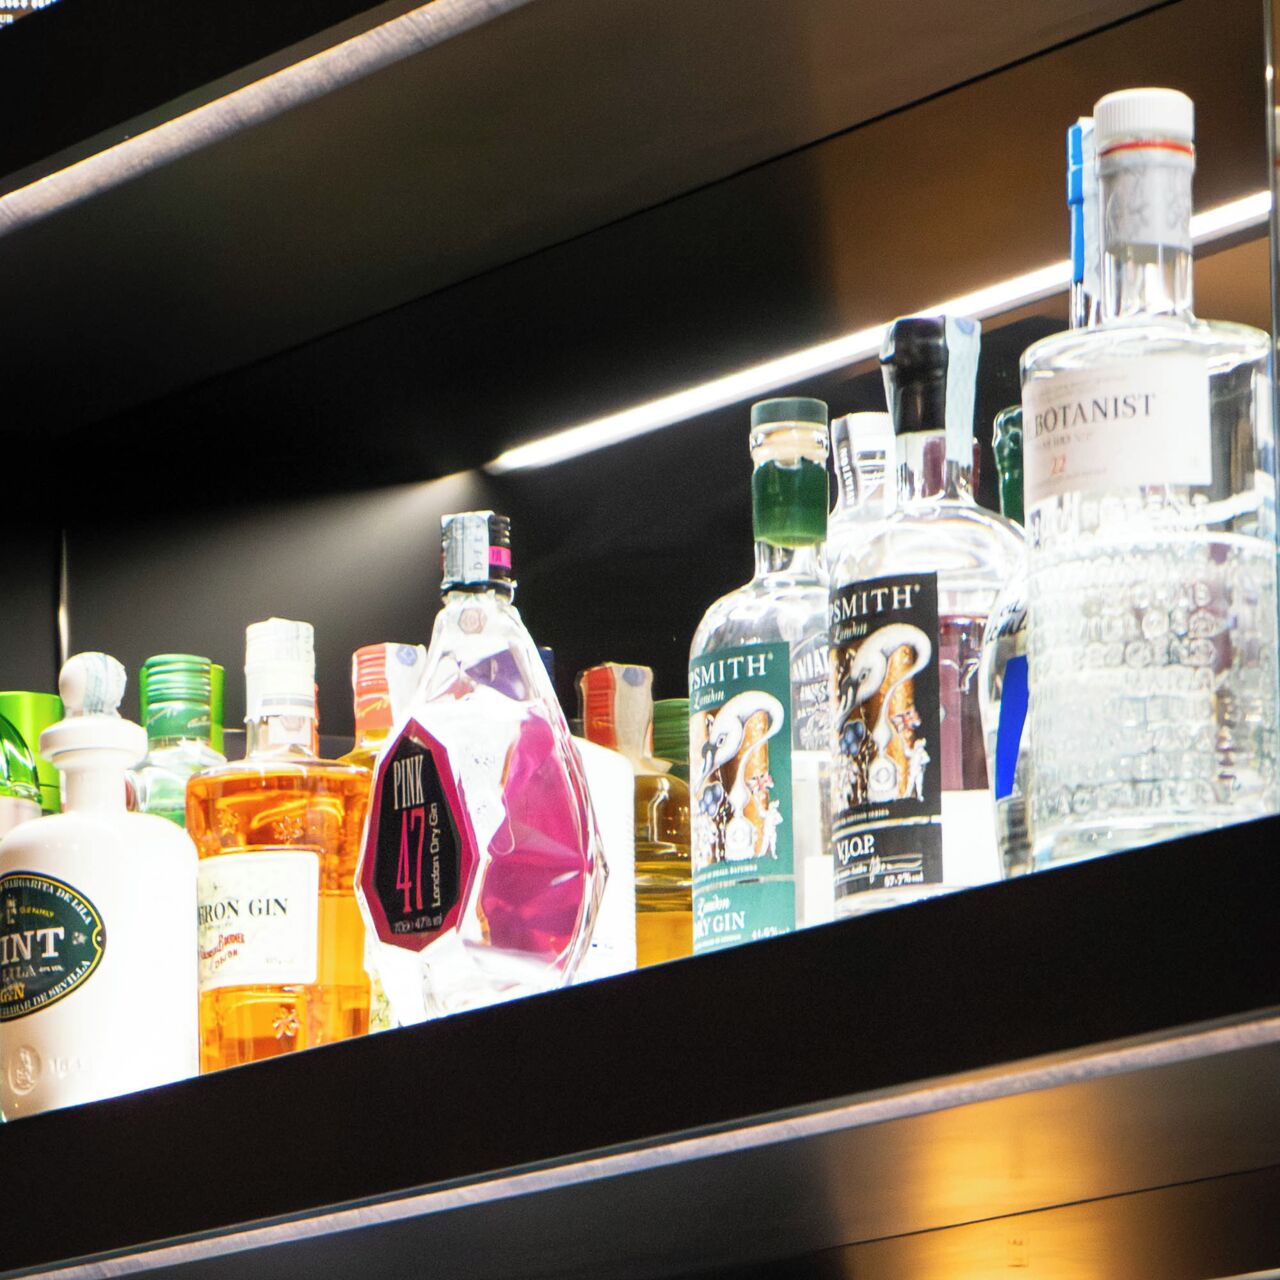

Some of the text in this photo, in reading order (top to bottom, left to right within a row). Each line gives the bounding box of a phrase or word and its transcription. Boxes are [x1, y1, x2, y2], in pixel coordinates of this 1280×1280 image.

[1035, 394, 1156, 438] BOTANIST
[393, 754, 425, 810] PINK
[395, 805, 426, 914] 47
[429, 827, 441, 854] Dry
[431, 855, 441, 908] London
[71, 897, 94, 926] LILA
[248, 898, 288, 917] GIN
[713, 911, 746, 933] GIN
[0, 926, 65, 966] INT
